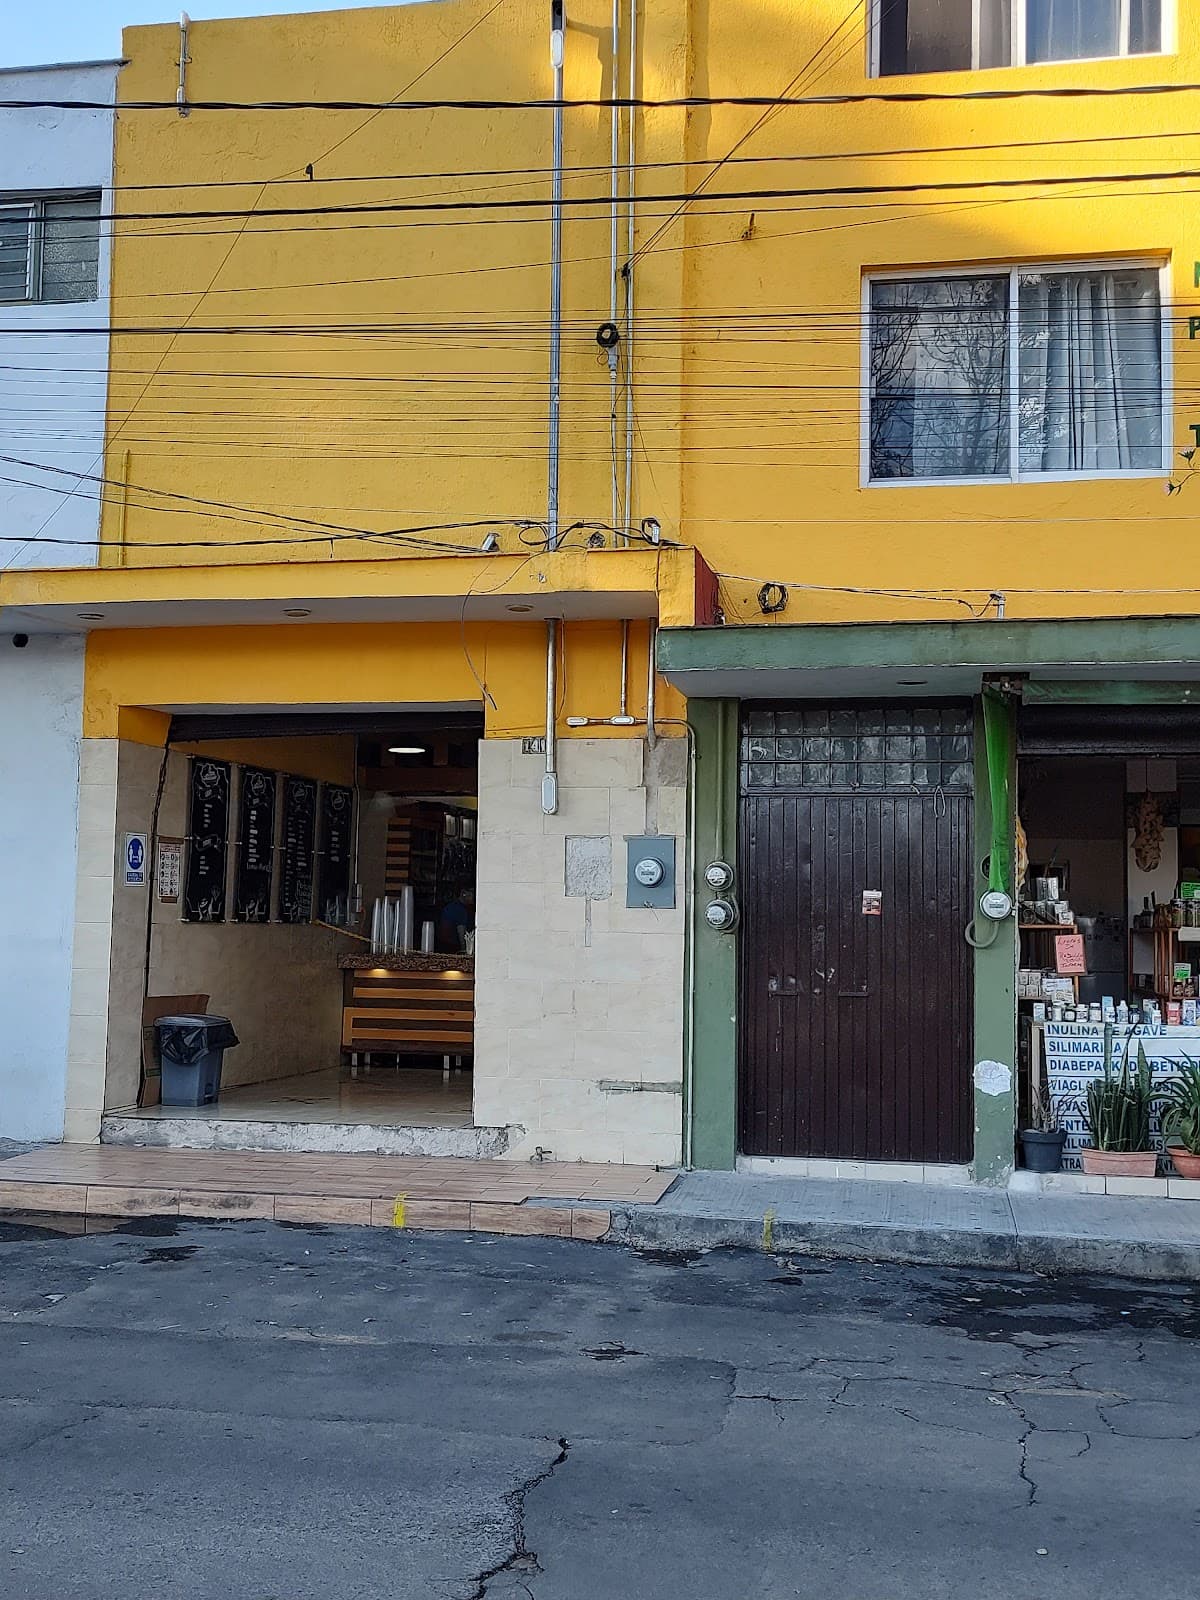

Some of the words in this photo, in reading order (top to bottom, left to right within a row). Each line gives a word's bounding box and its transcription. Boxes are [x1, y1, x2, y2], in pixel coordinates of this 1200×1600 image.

[1047, 1025, 1099, 1036] INULINA
[1124, 1025, 1167, 1036] AGAVE
[1049, 1041, 1122, 1053] SILIMARIA
[1050, 1060, 1120, 1071] DIABEPAK
